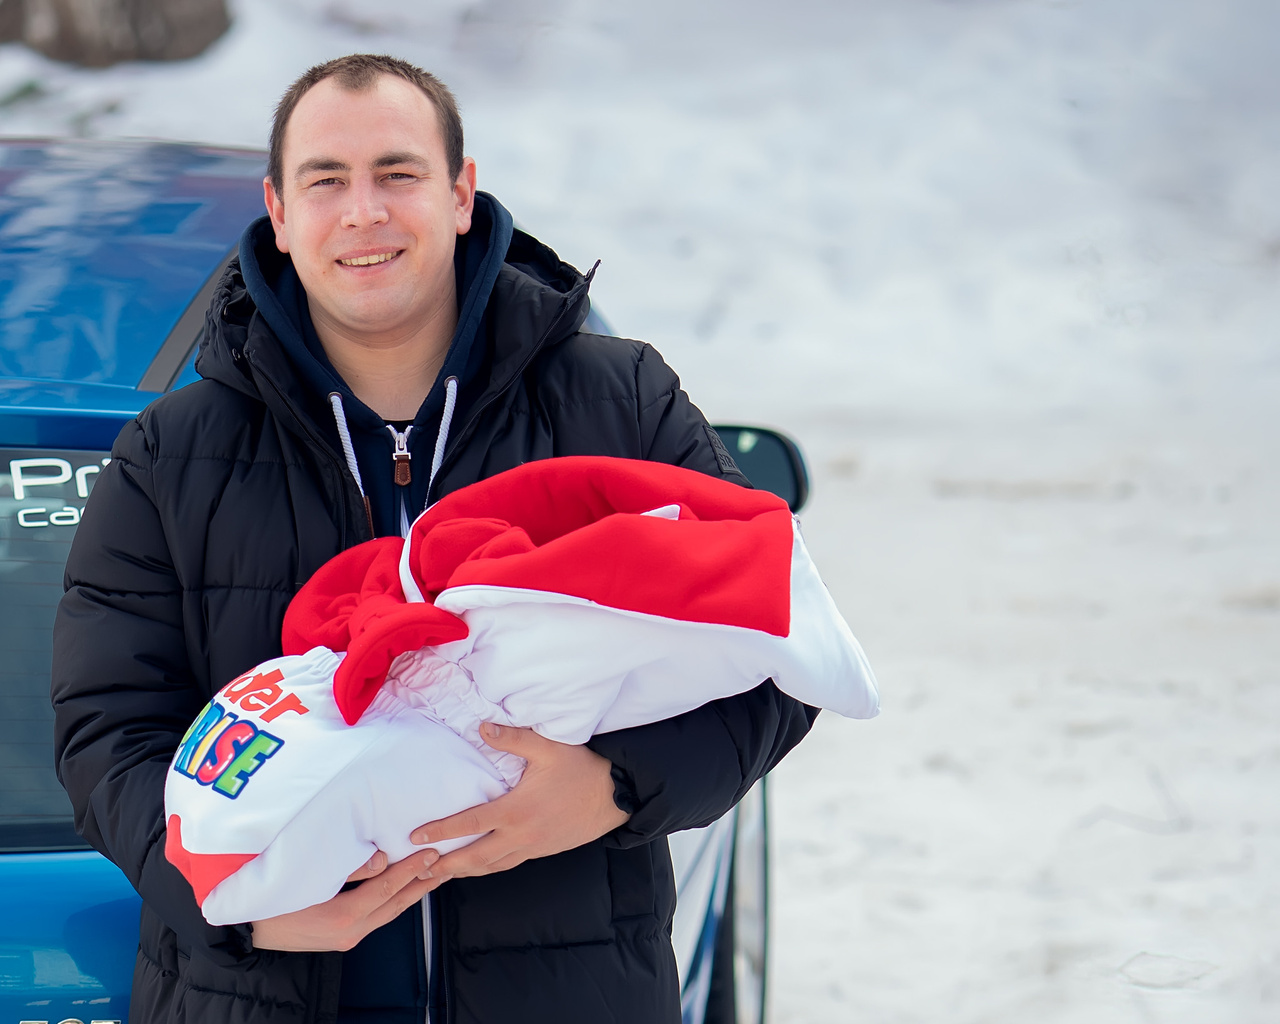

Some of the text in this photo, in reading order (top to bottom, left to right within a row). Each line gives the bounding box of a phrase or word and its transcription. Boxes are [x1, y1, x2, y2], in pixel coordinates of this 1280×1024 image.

[10, 457, 111, 500] Pr
[17, 506, 85, 528] ca
[220, 666, 310, 723] der
